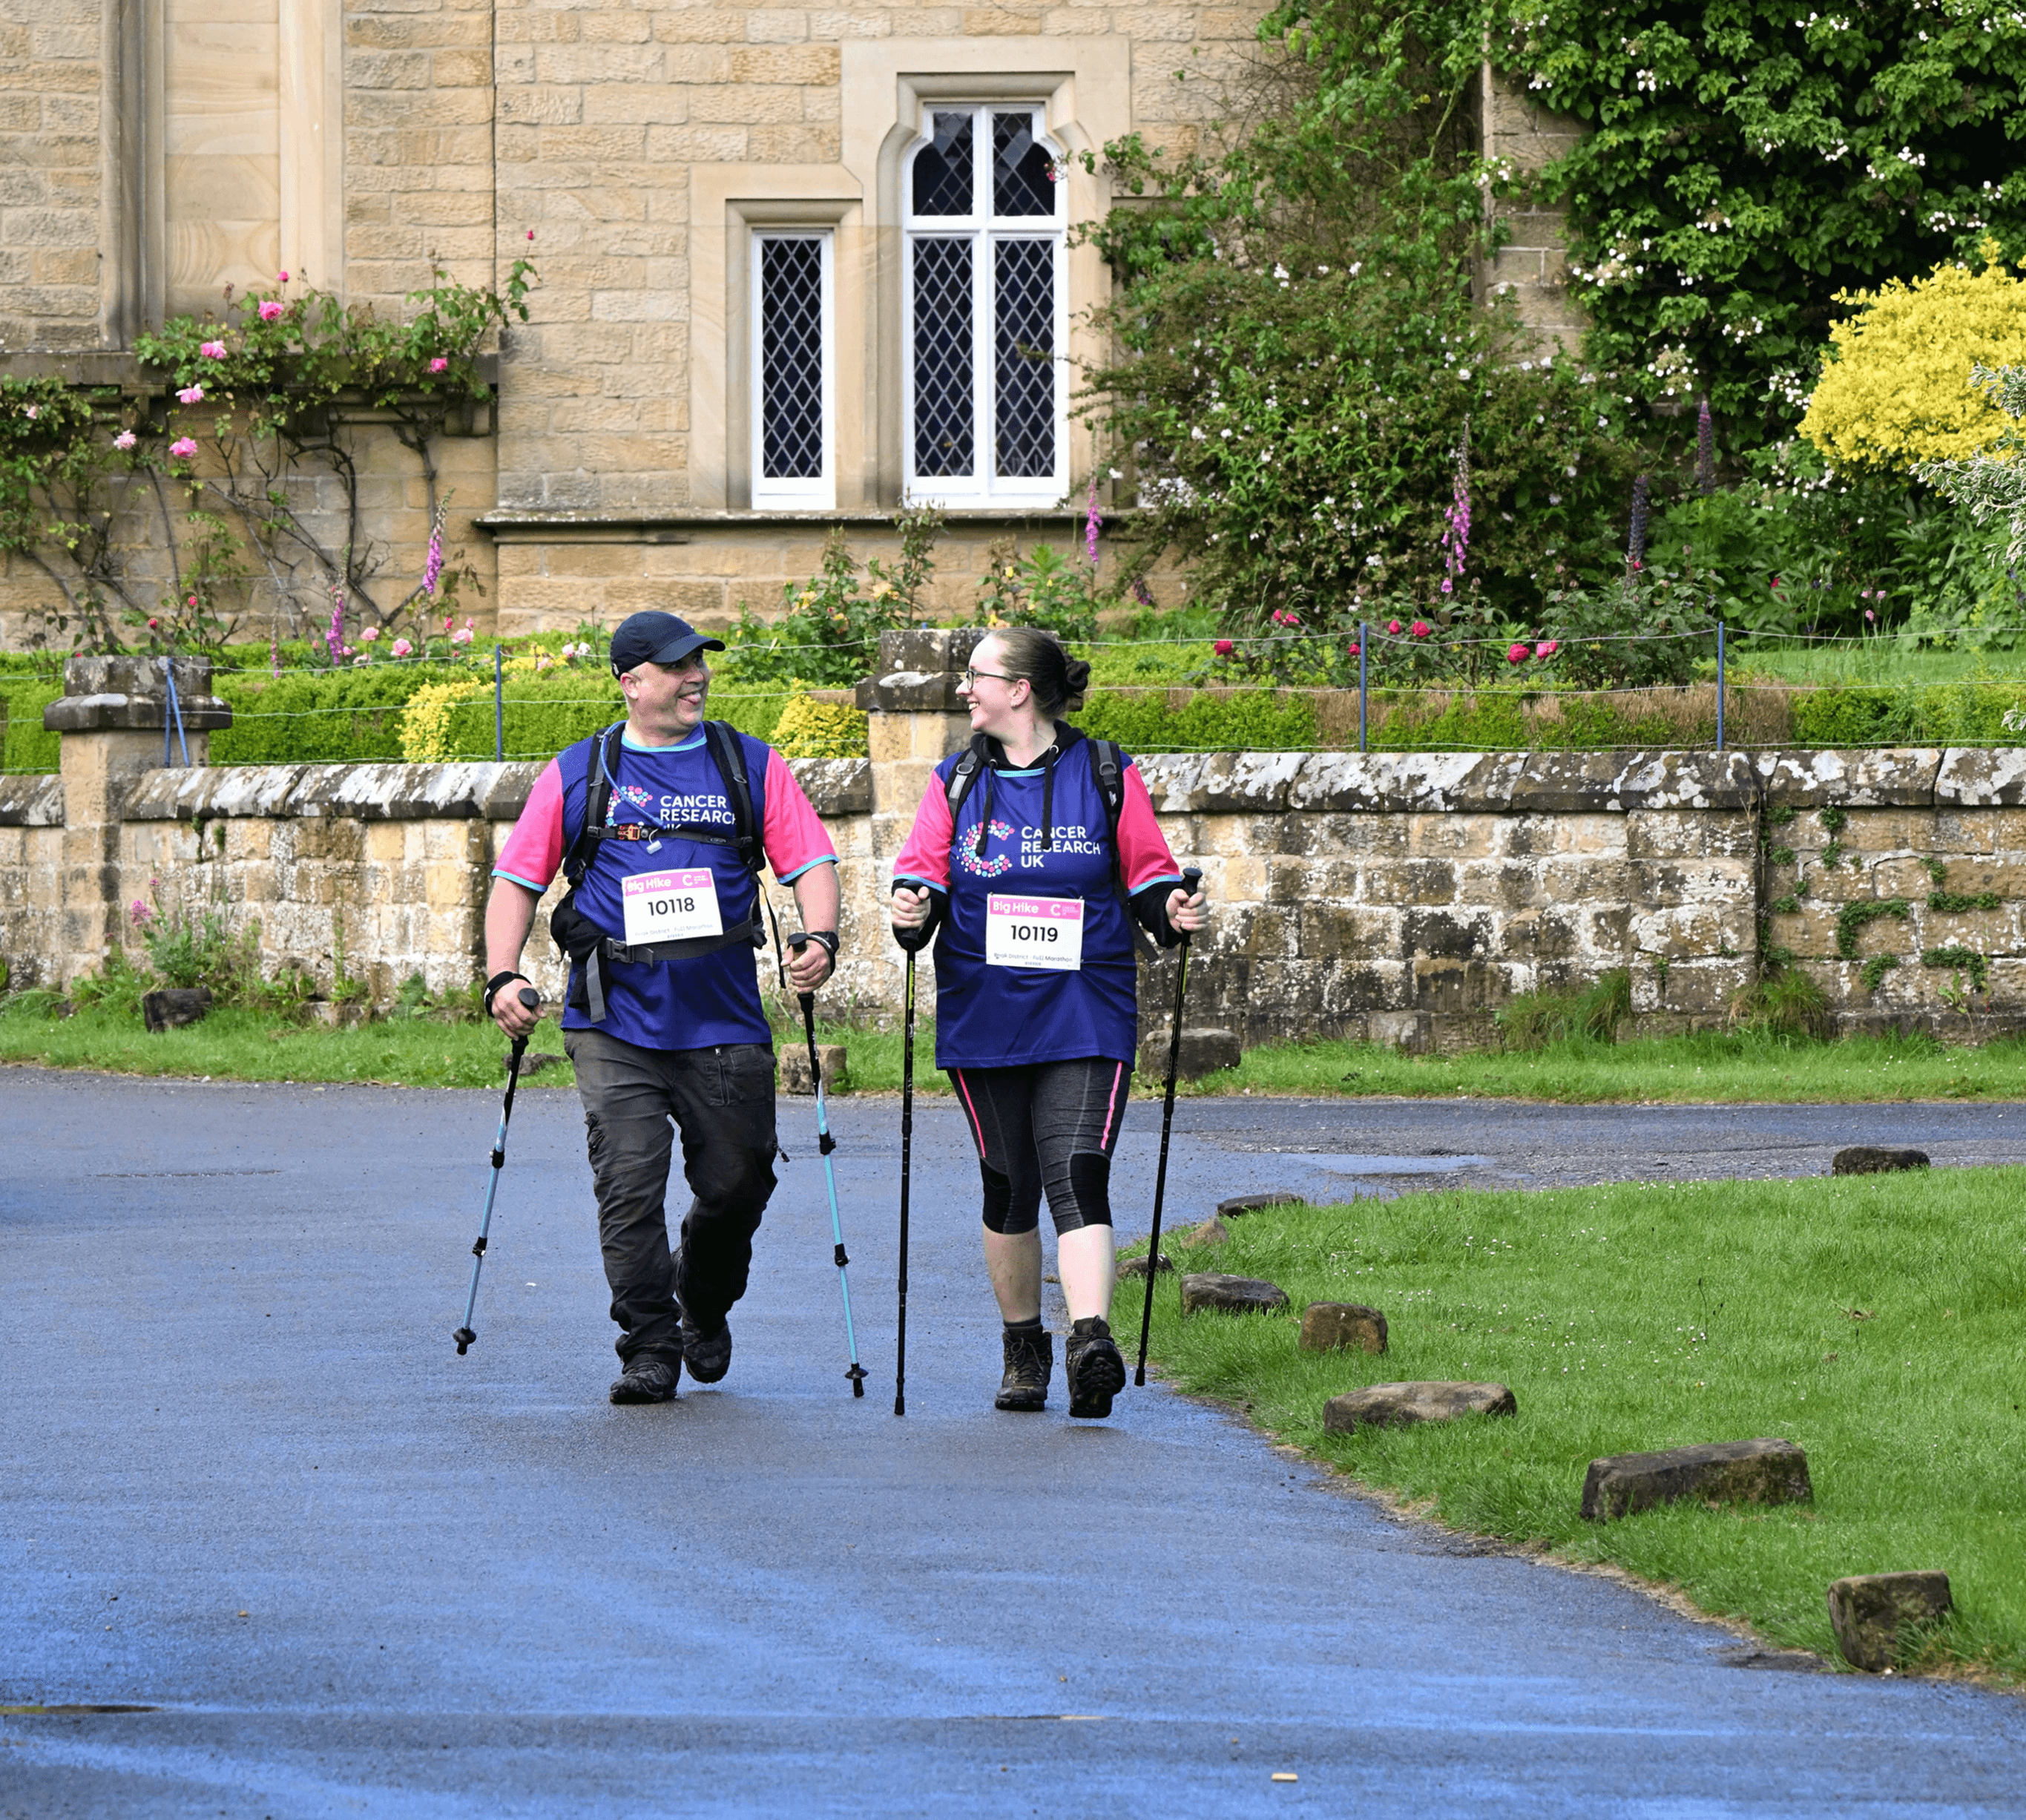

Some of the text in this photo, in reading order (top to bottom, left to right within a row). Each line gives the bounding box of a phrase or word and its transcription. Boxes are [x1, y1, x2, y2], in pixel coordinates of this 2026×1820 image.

[660, 795, 727, 809] CANCER
[1021, 855, 1045, 868] UK
[627, 877, 672, 893] Big Hike
[648, 897, 695, 916] 10118
[993, 900, 1039, 914] Big Hike
[1010, 924, 1059, 942] 10119
